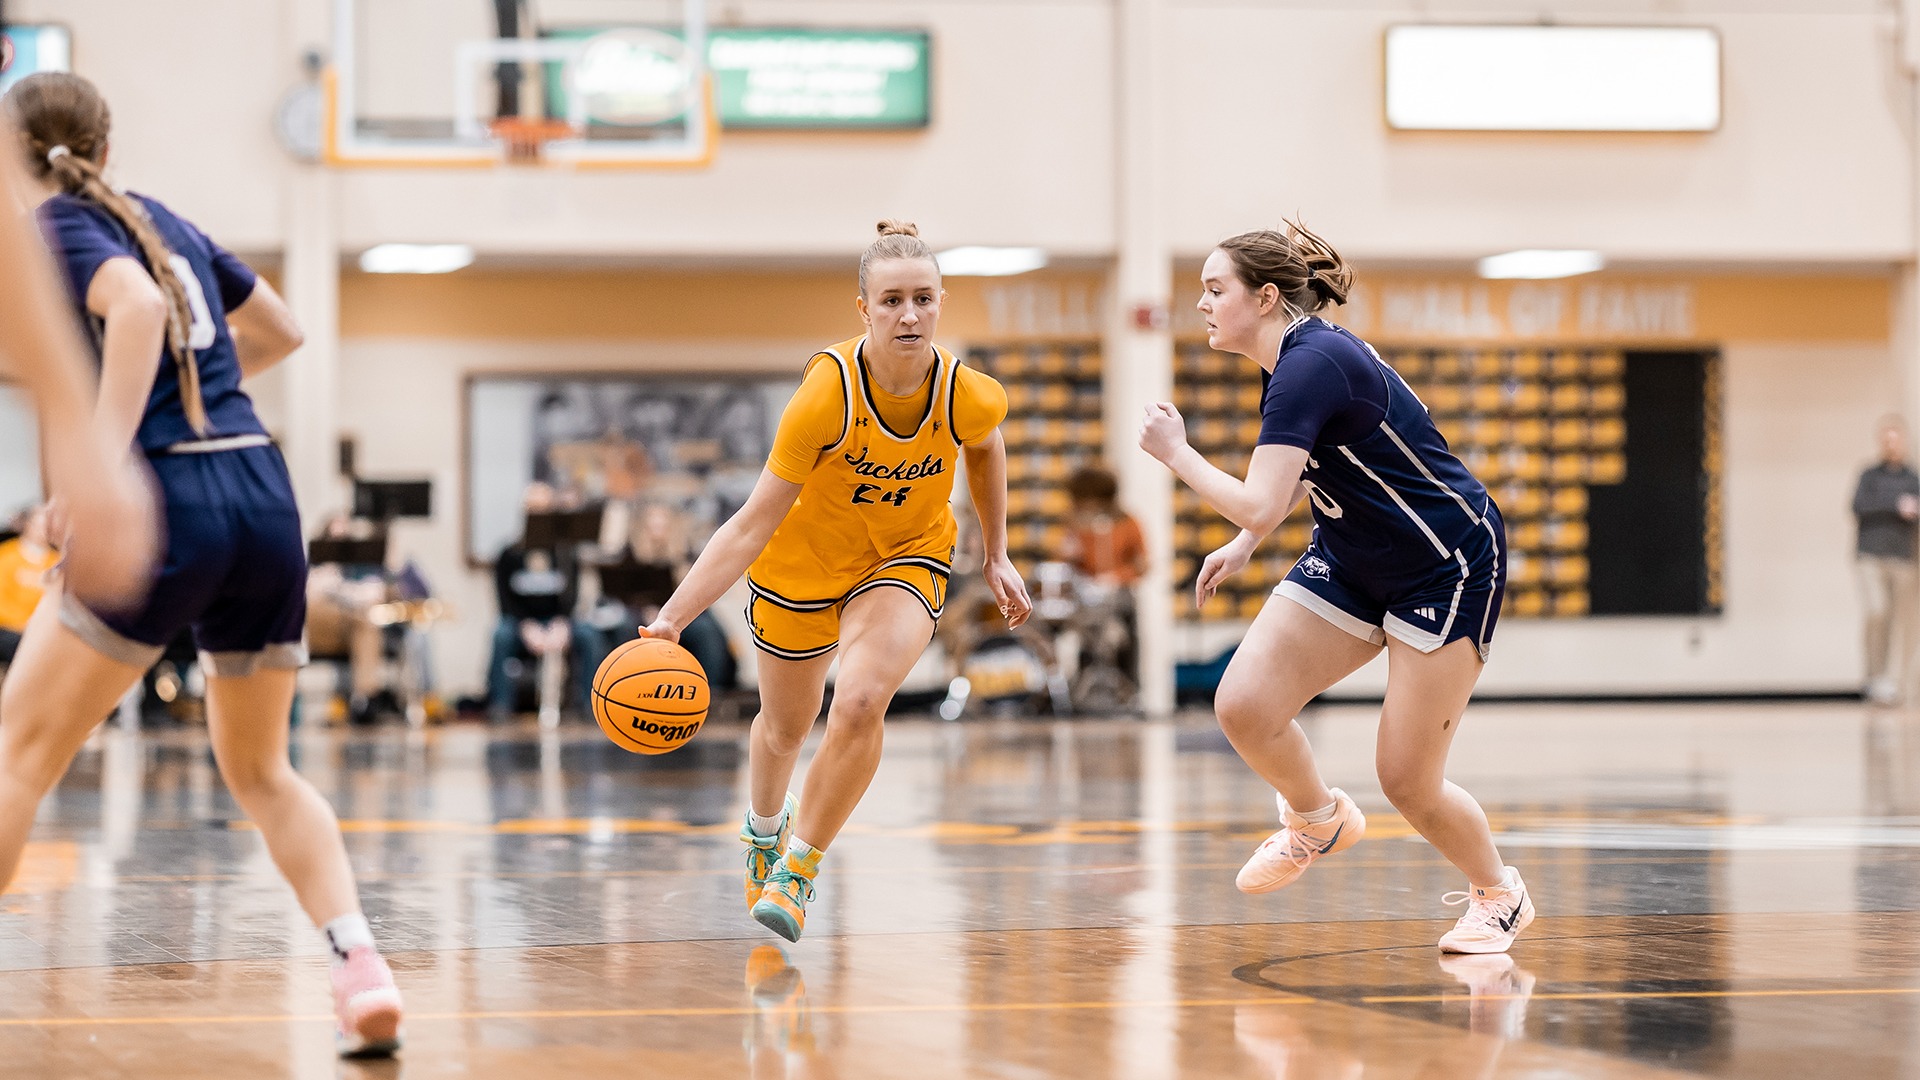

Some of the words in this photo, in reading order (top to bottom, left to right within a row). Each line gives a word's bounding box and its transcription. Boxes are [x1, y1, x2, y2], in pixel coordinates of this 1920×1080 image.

[844, 447, 945, 480] Jackets
[653, 684, 697, 700] EVO
[632, 716, 699, 741] Wilson
